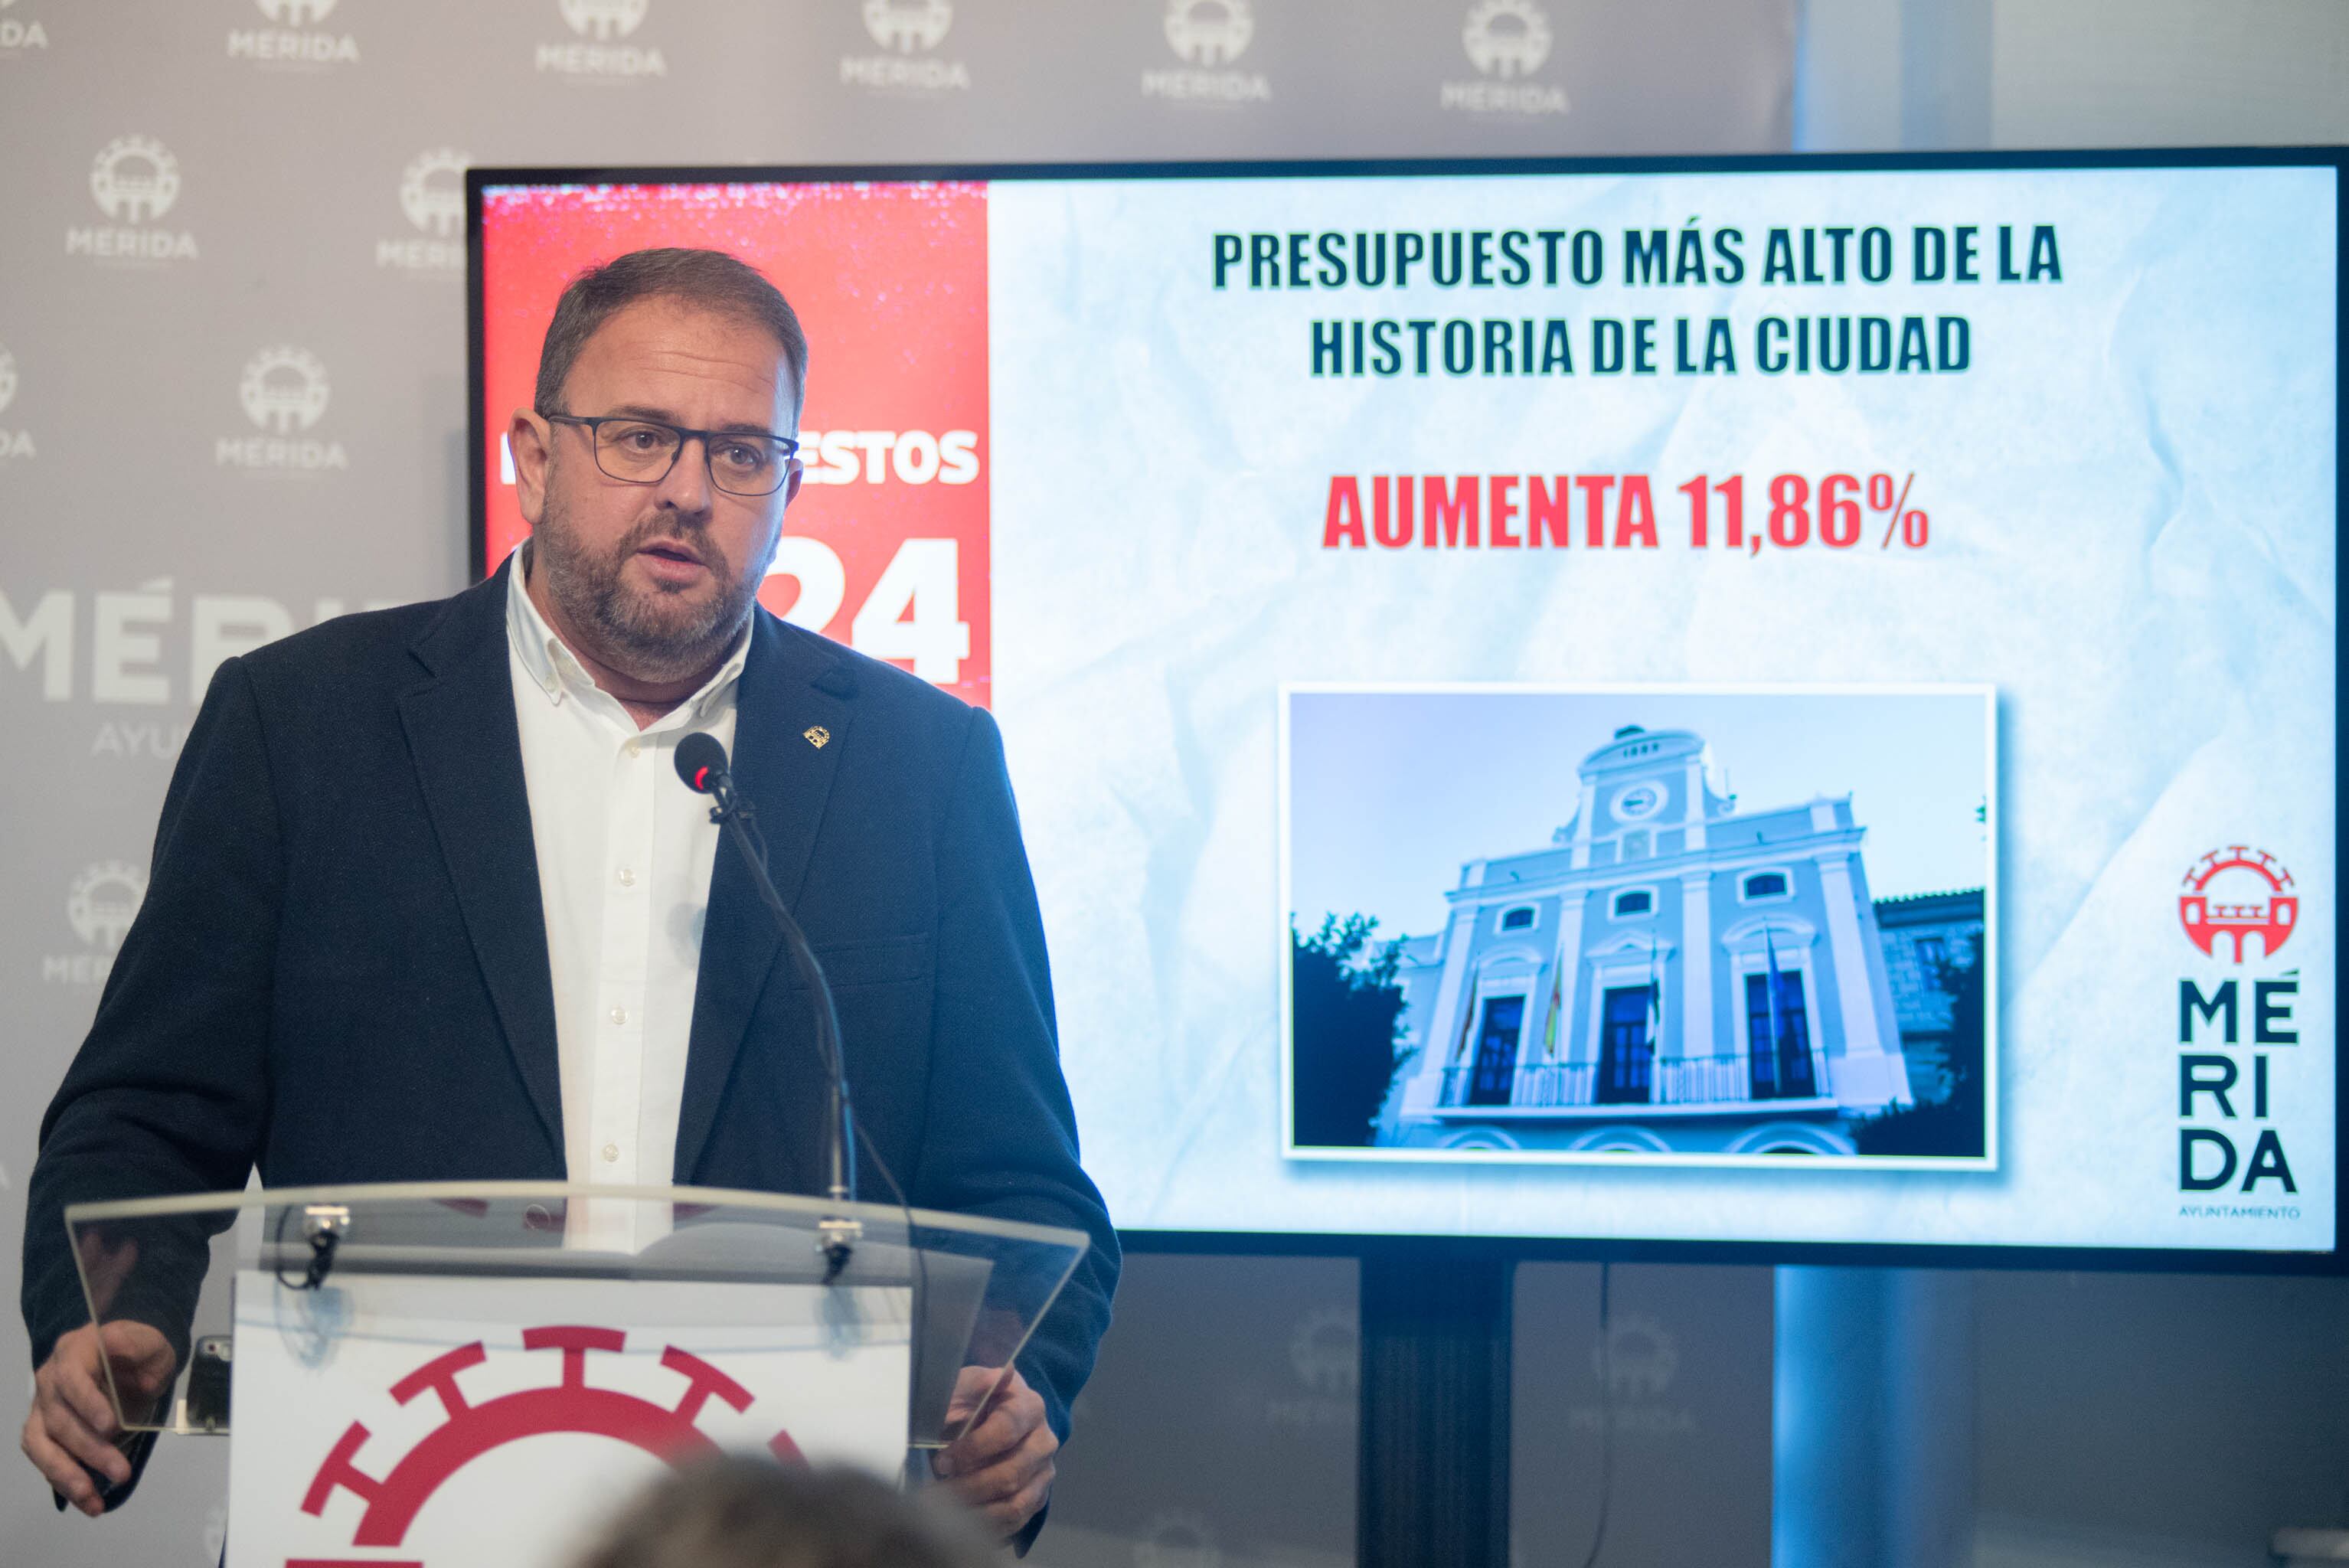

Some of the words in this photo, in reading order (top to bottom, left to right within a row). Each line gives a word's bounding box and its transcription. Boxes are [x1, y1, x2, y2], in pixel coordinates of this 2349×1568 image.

[1214, 228, 1604, 290] PRESUPUESTO
[1623, 216, 1746, 286] MÁS
[1761, 226, 1893, 285] ALTO
[1912, 226, 1981, 284] DE
[1997, 224, 2064, 283] LA
[1312, 319, 1575, 377] HISTORIA
[1591, 318, 1658, 374] DE
[1674, 318, 1738, 374] LA
[1755, 316, 1972, 374] CIUDAD
[1323, 475, 1659, 548] AUMENTA
[1678, 473, 1929, 556] 11,86%
[2180, 1206, 2302, 1220] AYUNTAMIENTO
